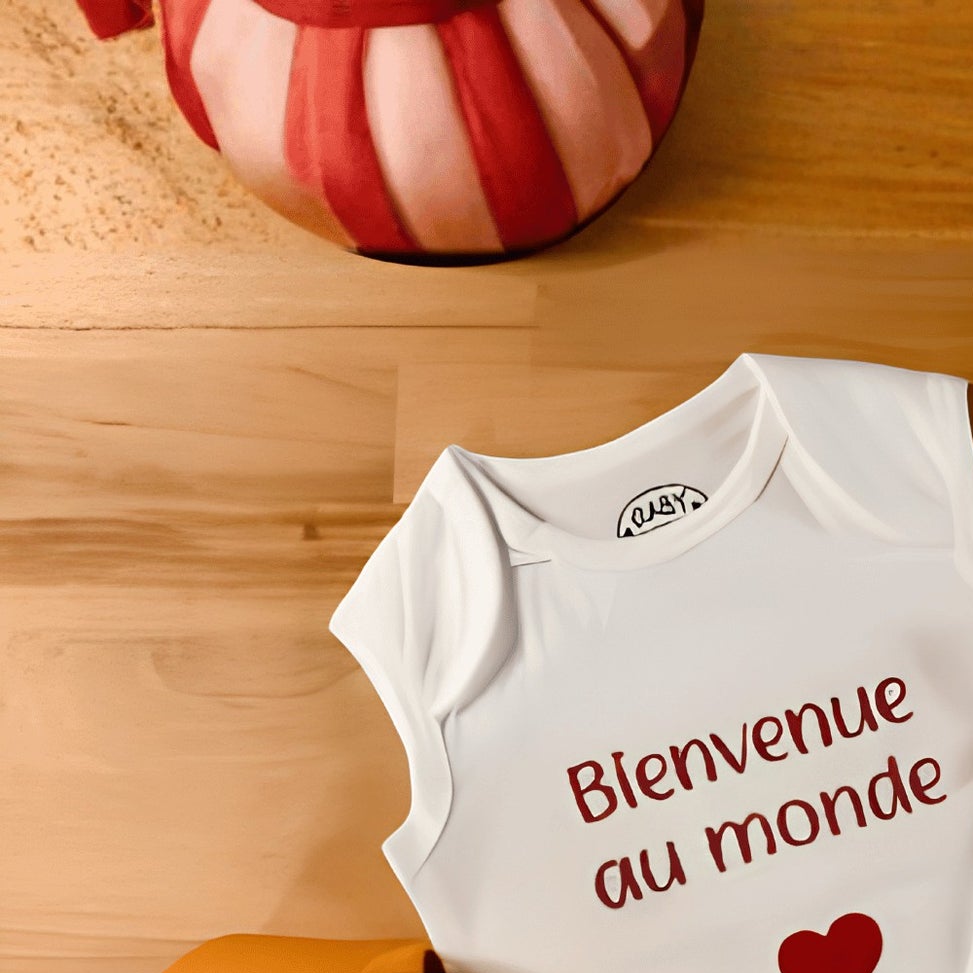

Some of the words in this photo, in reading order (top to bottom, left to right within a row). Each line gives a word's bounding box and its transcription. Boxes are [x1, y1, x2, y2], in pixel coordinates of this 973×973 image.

[567, 676, 914, 824] Bienvenue
[594, 840, 687, 910] au
[704, 755, 948, 873] monde
